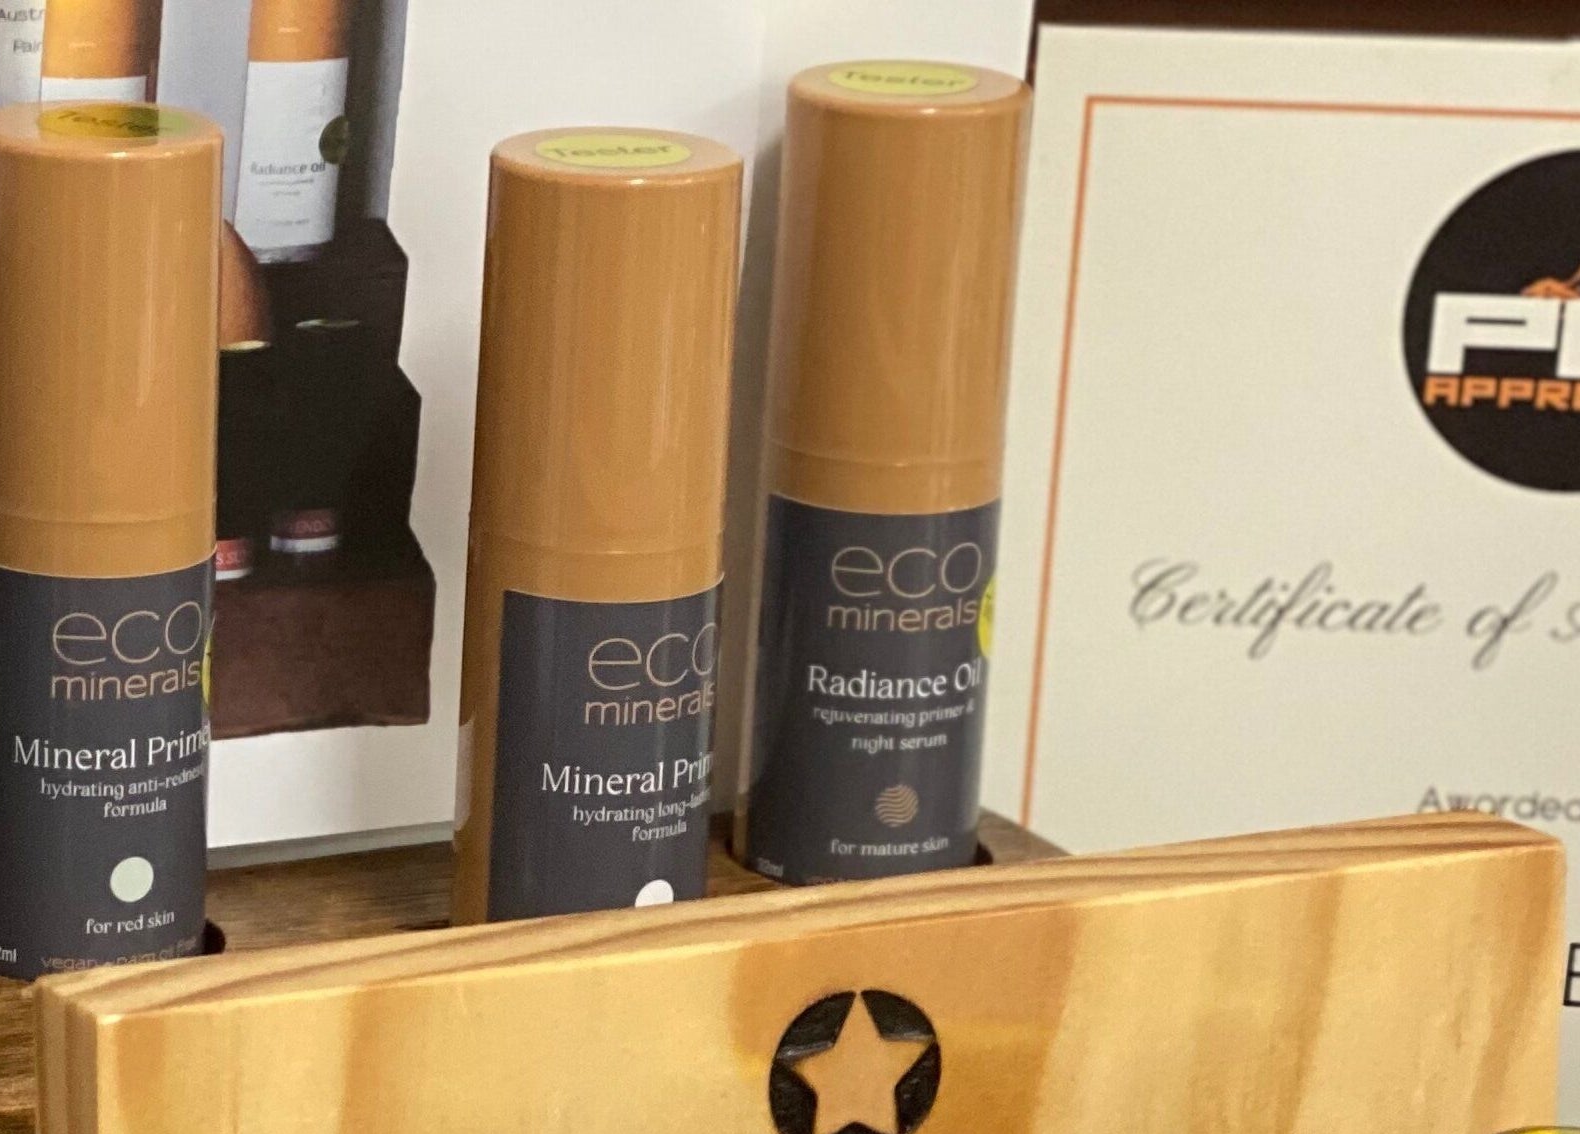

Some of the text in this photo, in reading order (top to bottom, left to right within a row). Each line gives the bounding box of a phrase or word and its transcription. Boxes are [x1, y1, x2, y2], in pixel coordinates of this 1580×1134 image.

[1423, 374, 1580, 412] APPR
[831, 541, 983, 599] eco
[826, 597, 979, 634] minerals
[1126, 556, 1446, 661] Certificate
[1464, 569, 1560, 672] of
[52, 600, 203, 665] eco
[50, 659, 202, 700] minerals
[807, 664, 947, 699] Radiance
[813, 705, 916, 729] rejuvenating
[919, 703, 963, 728] primer
[13, 734, 137, 771] Mineral
[851, 732, 948, 754] night serum
[40, 777, 125, 801] hydrating
[541, 762, 664, 796] Mineral
[103, 796, 168, 818] formula
[572, 804, 655, 827] hydrating
[631, 818, 688, 843] formula
[830, 836, 949, 857] for mature skin
[85, 910, 175, 935] for red skin
